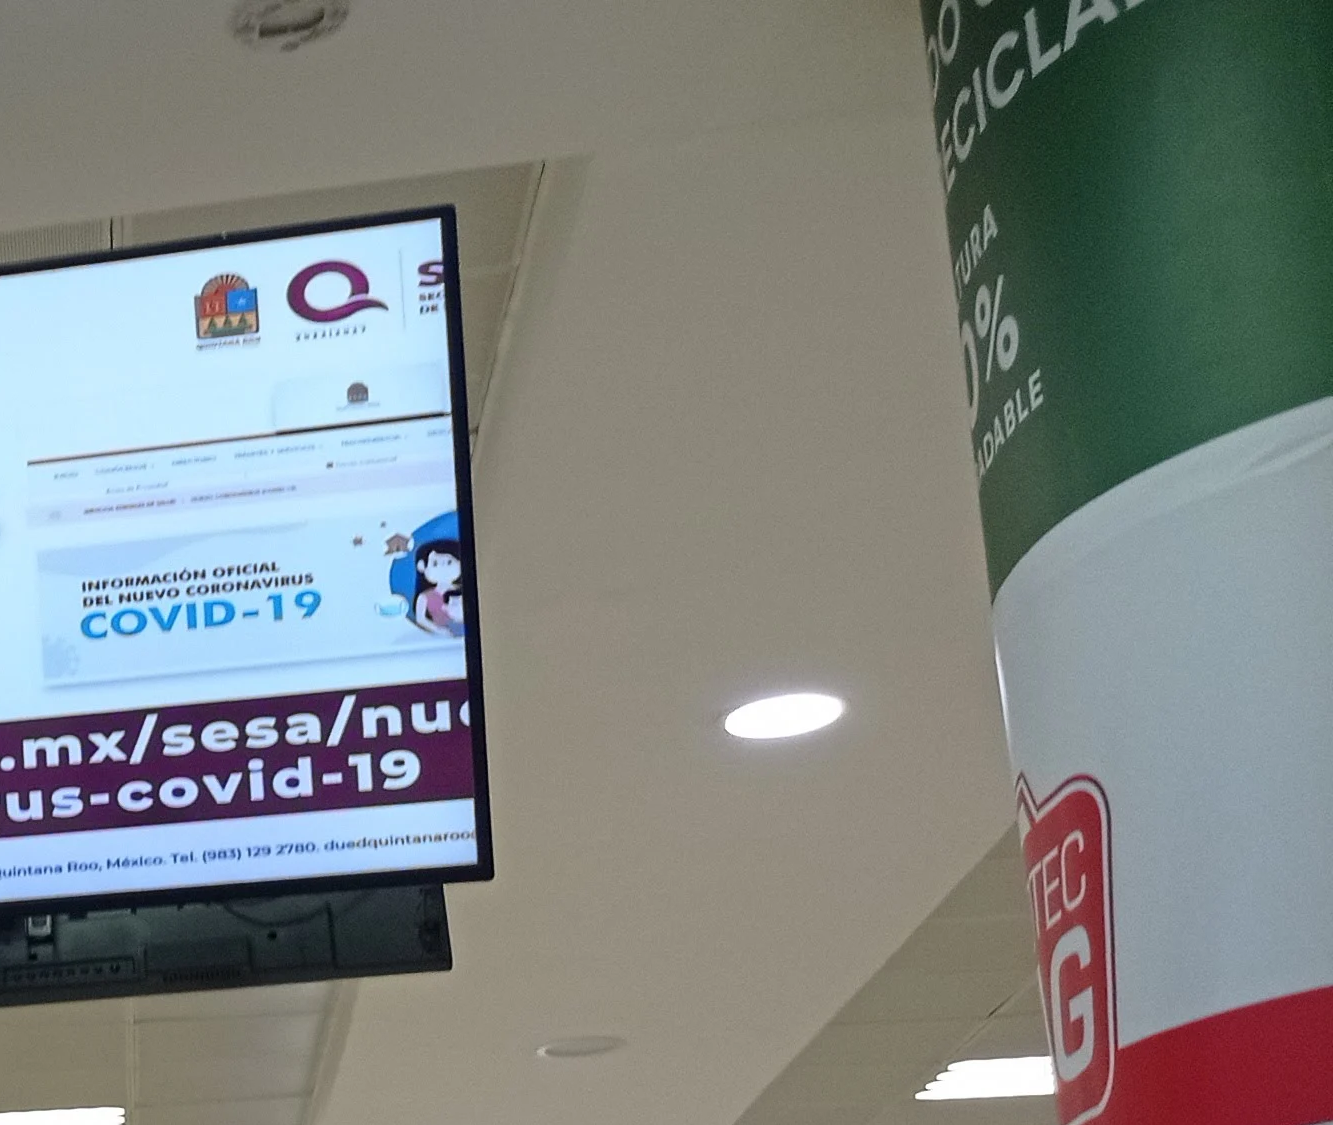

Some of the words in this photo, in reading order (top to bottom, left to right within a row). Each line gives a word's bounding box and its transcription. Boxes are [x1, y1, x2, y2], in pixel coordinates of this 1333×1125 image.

[81, 568, 206, 592] INFORMACIÓN
[212, 560, 280, 577] OFICIAL
[82, 594, 110, 607] DEL
[118, 588, 180, 604] NUEVO
[185, 573, 314, 596] CORONAVIRUS
[80, 589, 322, 639] COVID-19
